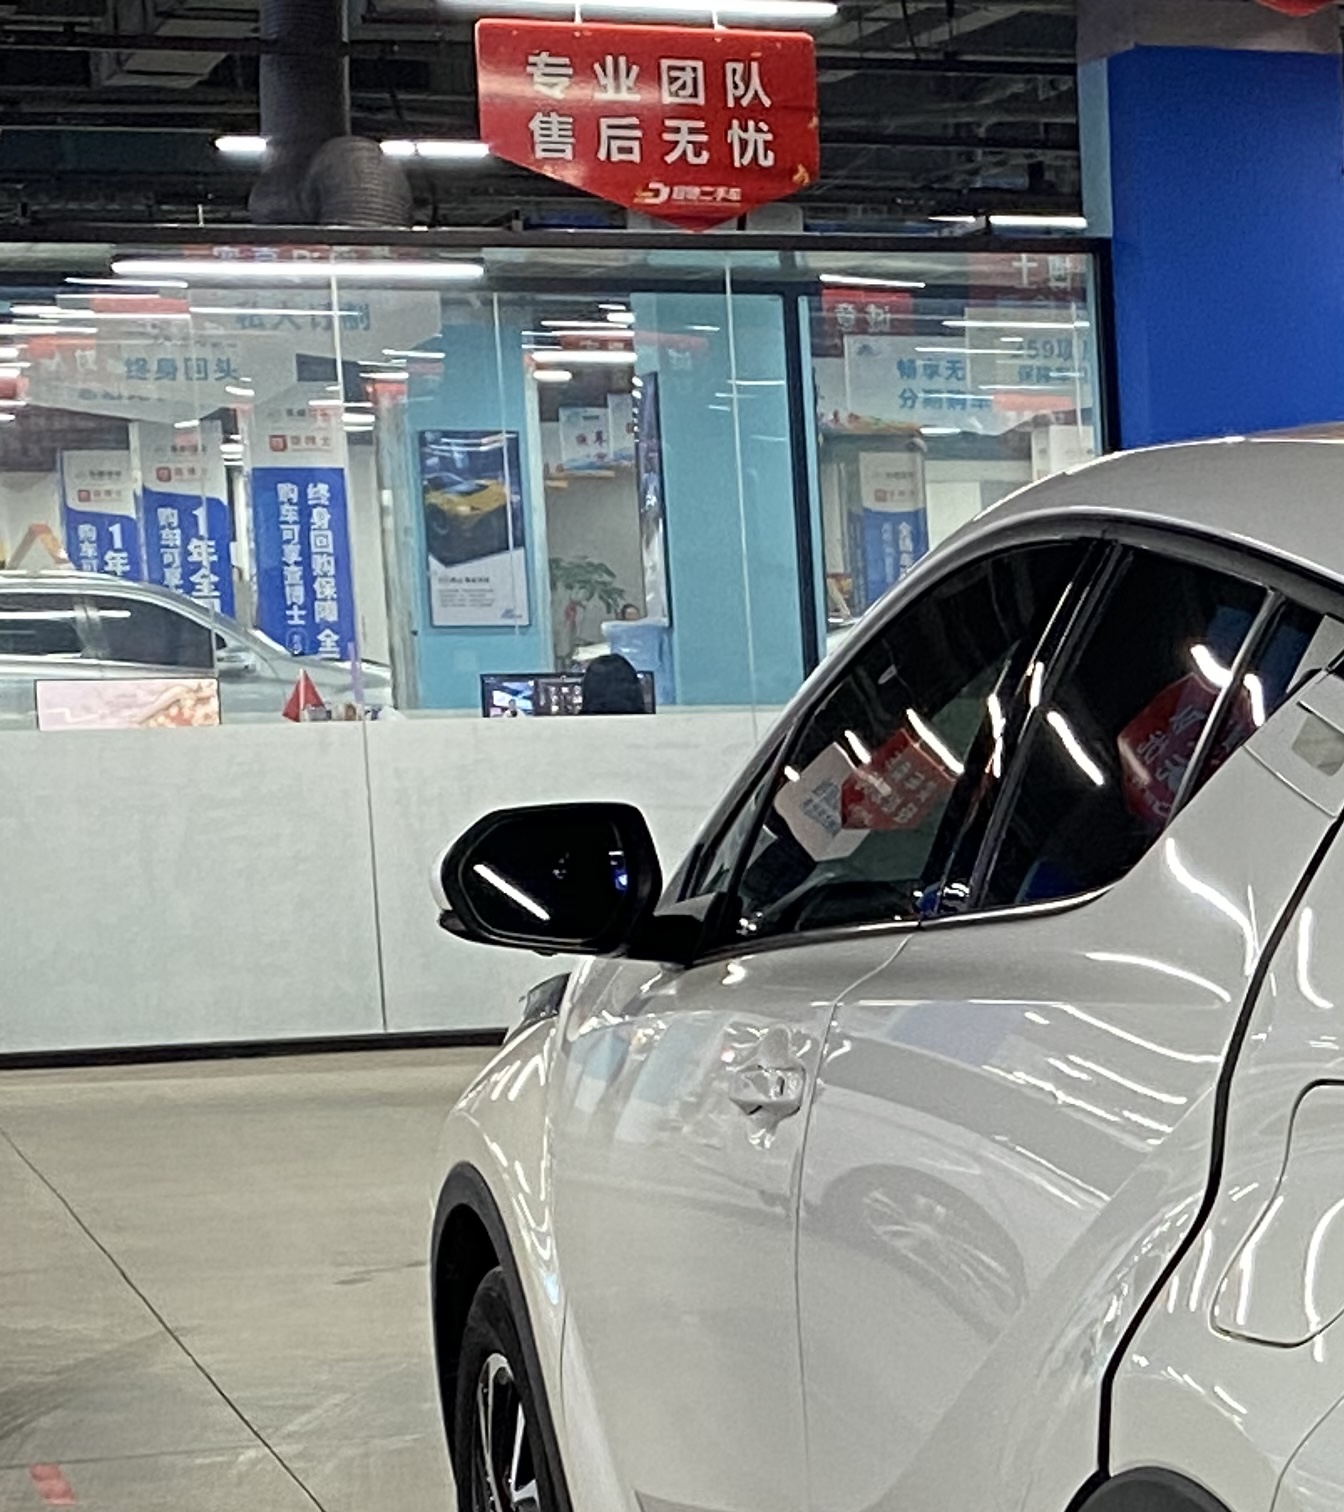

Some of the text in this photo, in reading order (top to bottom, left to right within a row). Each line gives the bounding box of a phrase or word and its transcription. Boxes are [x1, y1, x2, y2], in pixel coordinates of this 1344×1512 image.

[526, 51, 773, 108] 专业团队
[528, 111, 775, 168] 售后无忧
